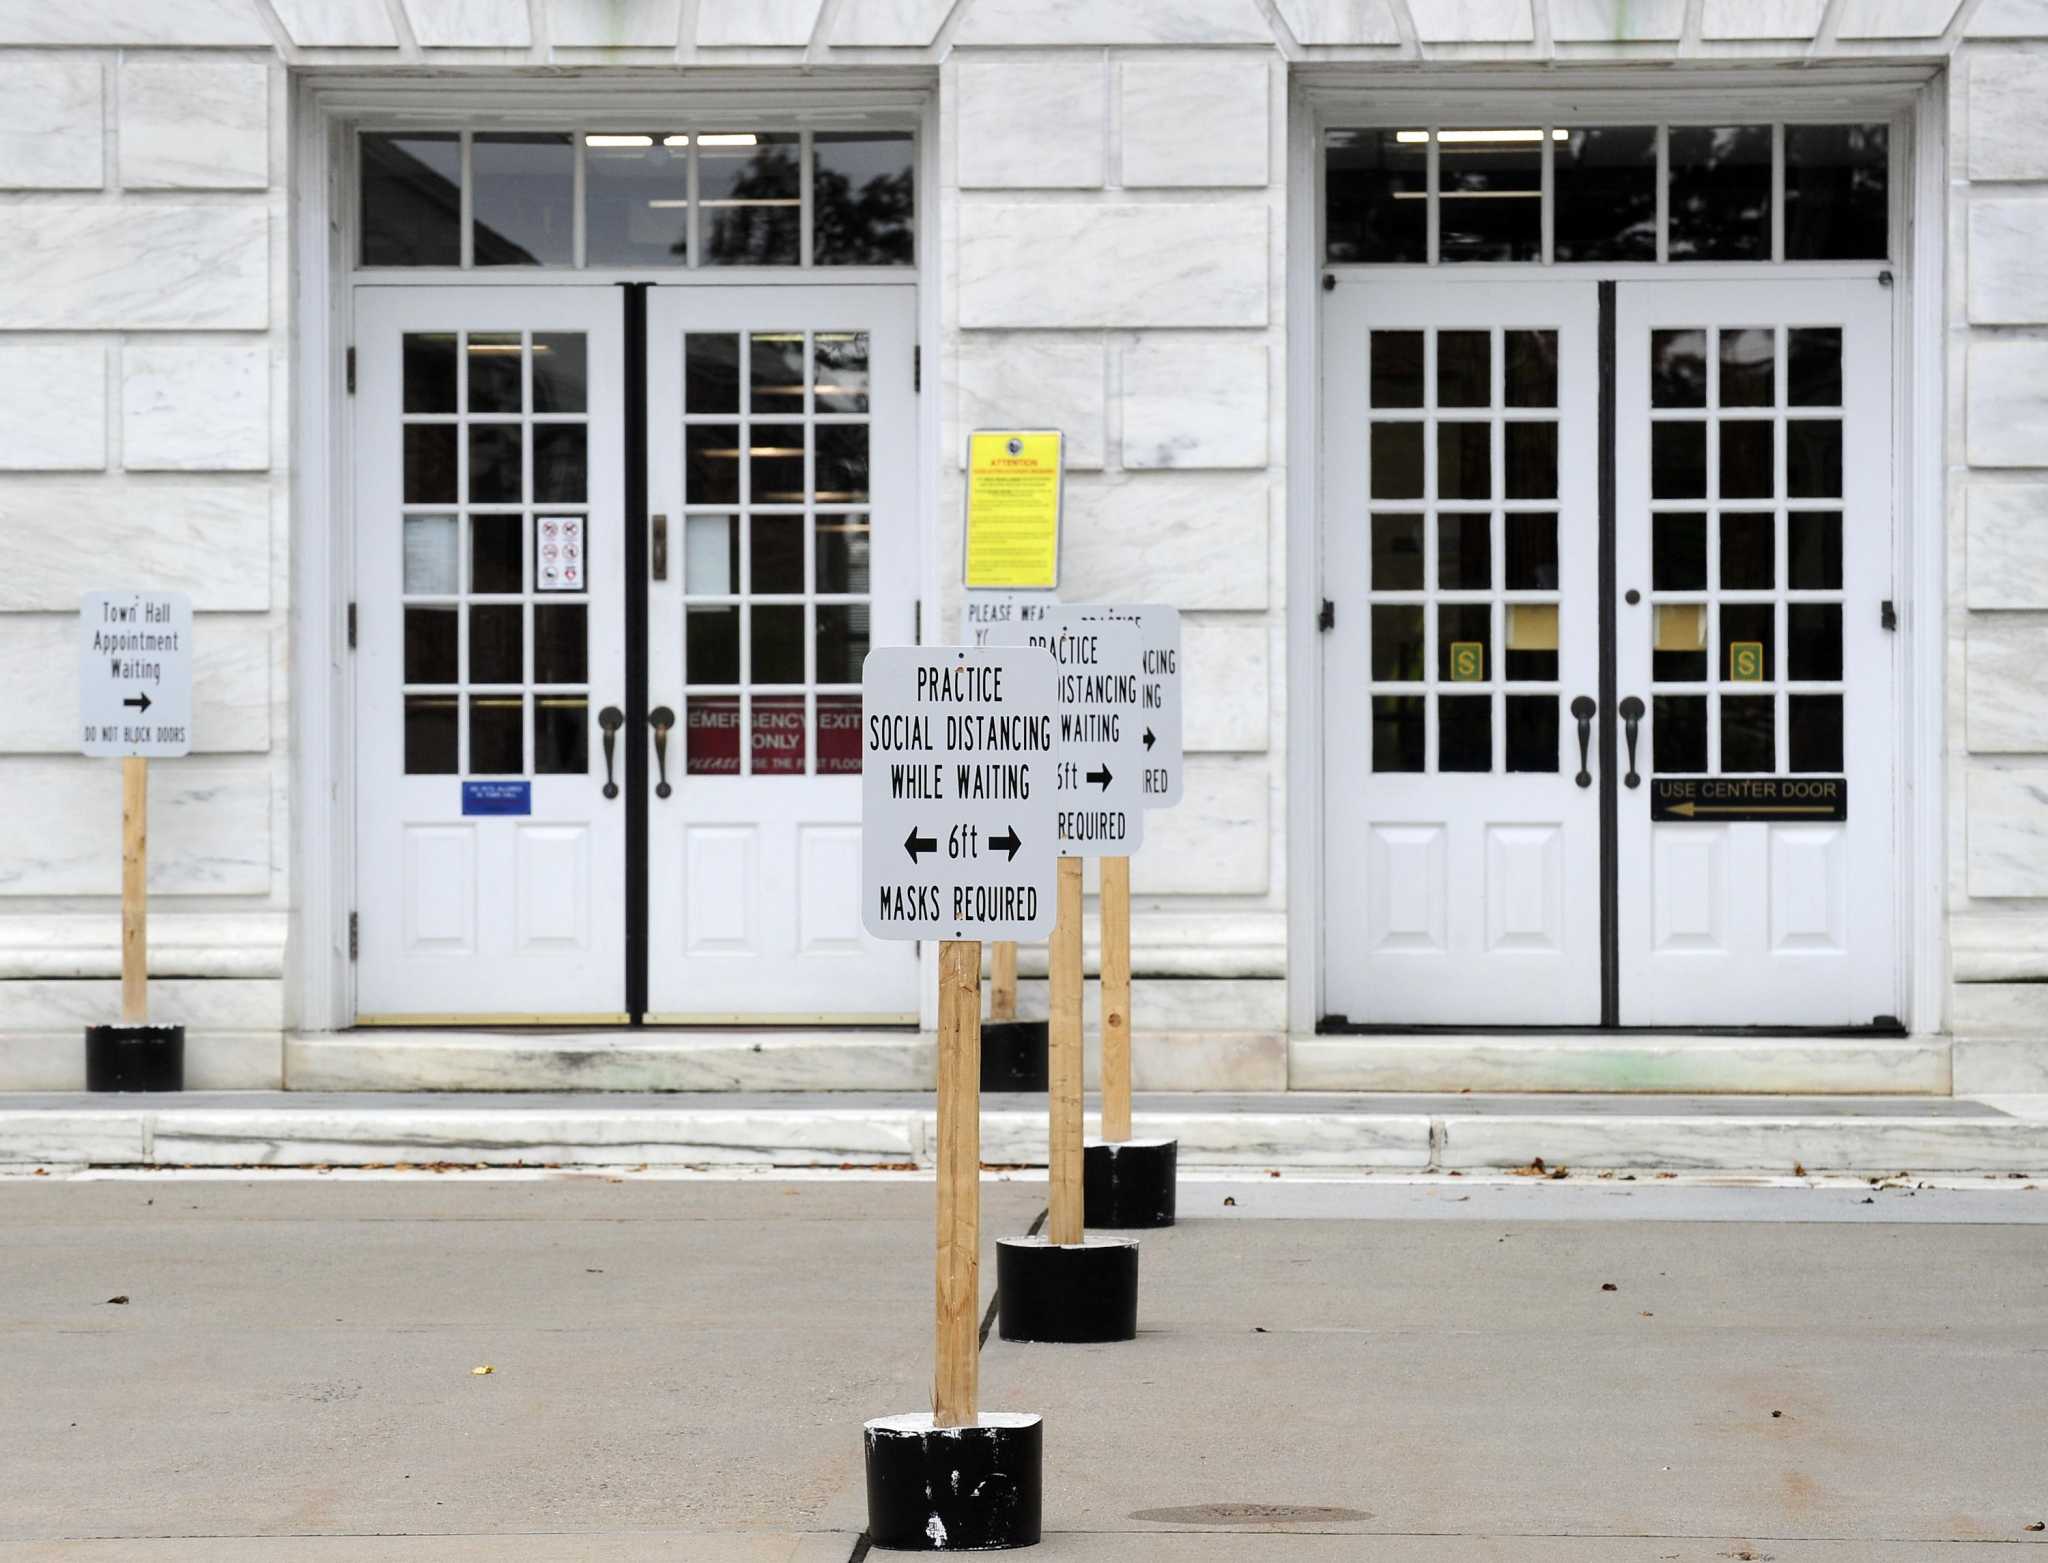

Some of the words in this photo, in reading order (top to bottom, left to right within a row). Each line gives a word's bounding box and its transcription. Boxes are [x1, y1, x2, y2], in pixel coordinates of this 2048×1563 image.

[104, 602, 137, 623] Town
[146, 602, 171, 623] Hall
[968, 604, 1012, 622] PLEASE
[1021, 605, 1050, 621] WEA
[94, 630, 179, 655] Appointment
[111, 658, 161, 685] Waiting
[917, 667, 1003, 702] PRACTICE
[84, 726, 97, 743] DO
[102, 726, 119, 743] NOT
[123, 726, 151, 744] BLOCK
[156, 726, 186, 743] DOORS
[751, 733, 800, 749] ONLY
[870, 715, 933, 751] SOCIAL
[947, 715, 1050, 751] DISTANCING
[1060, 714, 1119, 742] WAITING
[891, 764, 943, 799] WHILE
[957, 764, 1030, 800] WAITING
[1659, 783, 1696, 798] USE
[1702, 783, 1777, 798] CENTER
[1782, 783, 1838, 798] DOOR
[1058, 812, 1125, 840] REQUIRED
[949, 824, 978, 859] 6ft
[880, 885, 940, 921] MASKS
[954, 886, 1037, 922] REQUIRED
